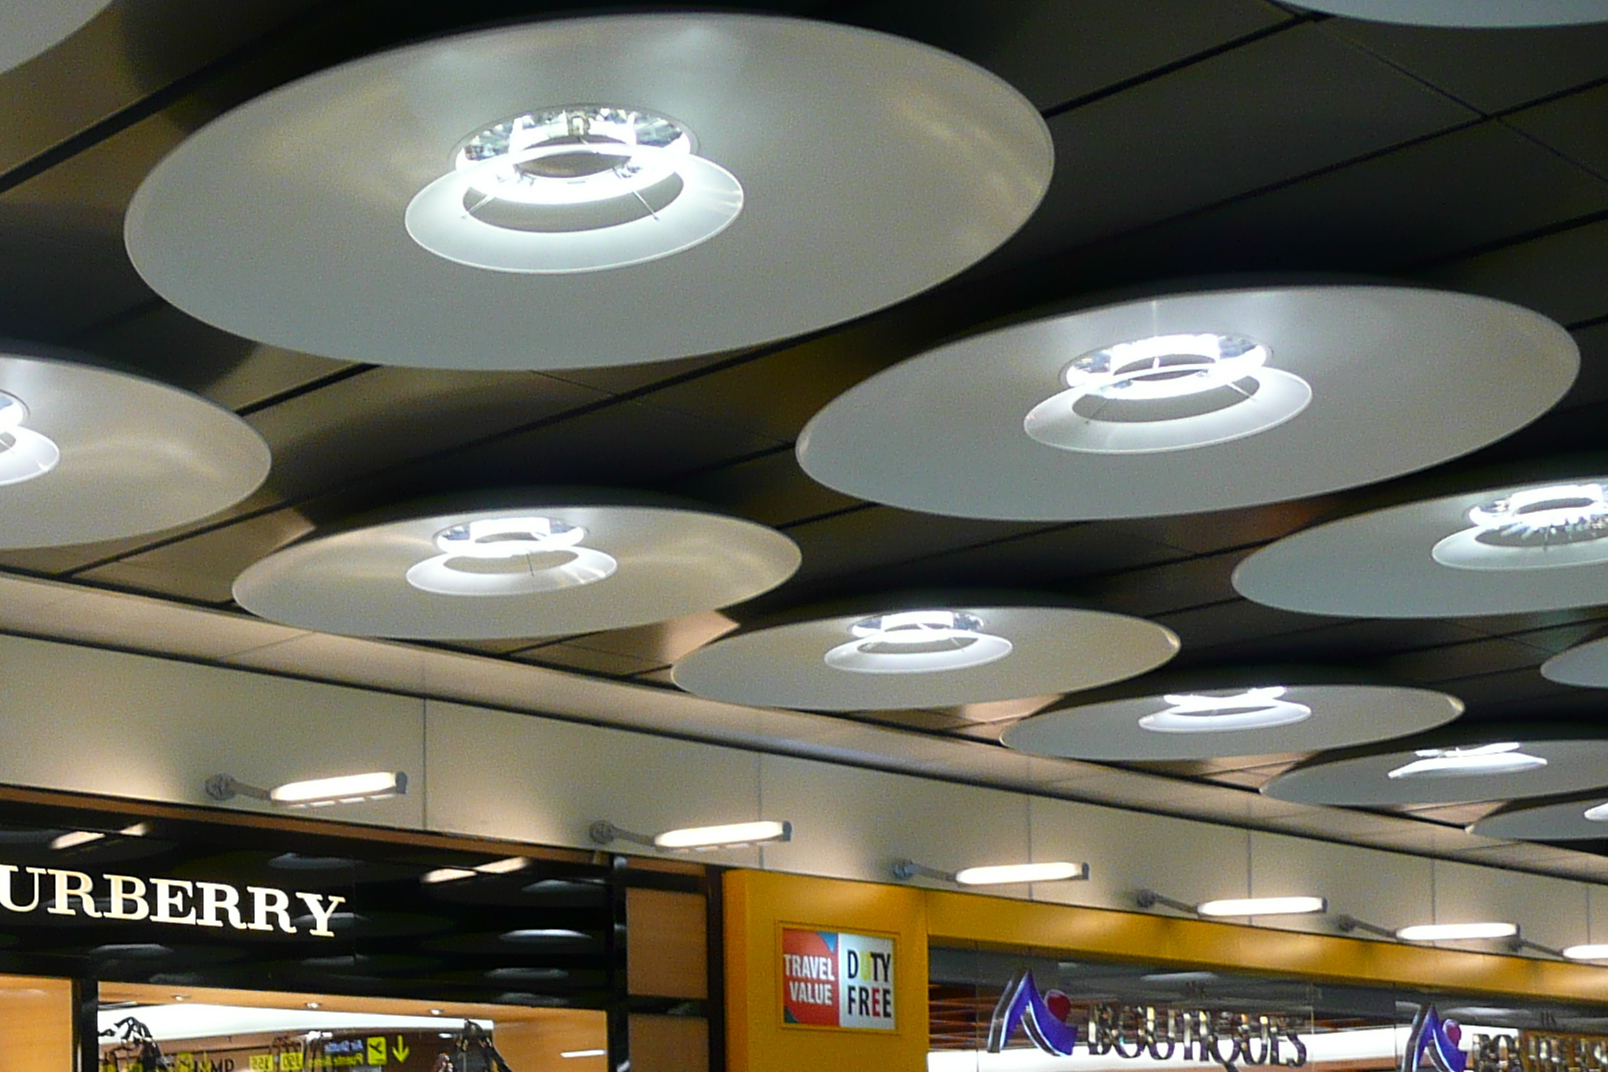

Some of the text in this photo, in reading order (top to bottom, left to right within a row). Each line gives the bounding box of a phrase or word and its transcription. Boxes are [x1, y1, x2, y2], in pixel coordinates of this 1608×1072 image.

[784, 953, 835, 981] TRAVEL
[847, 949, 891, 983] DUTY
[789, 980, 833, 1006] VALUE
[847, 985, 892, 1019] FREE
